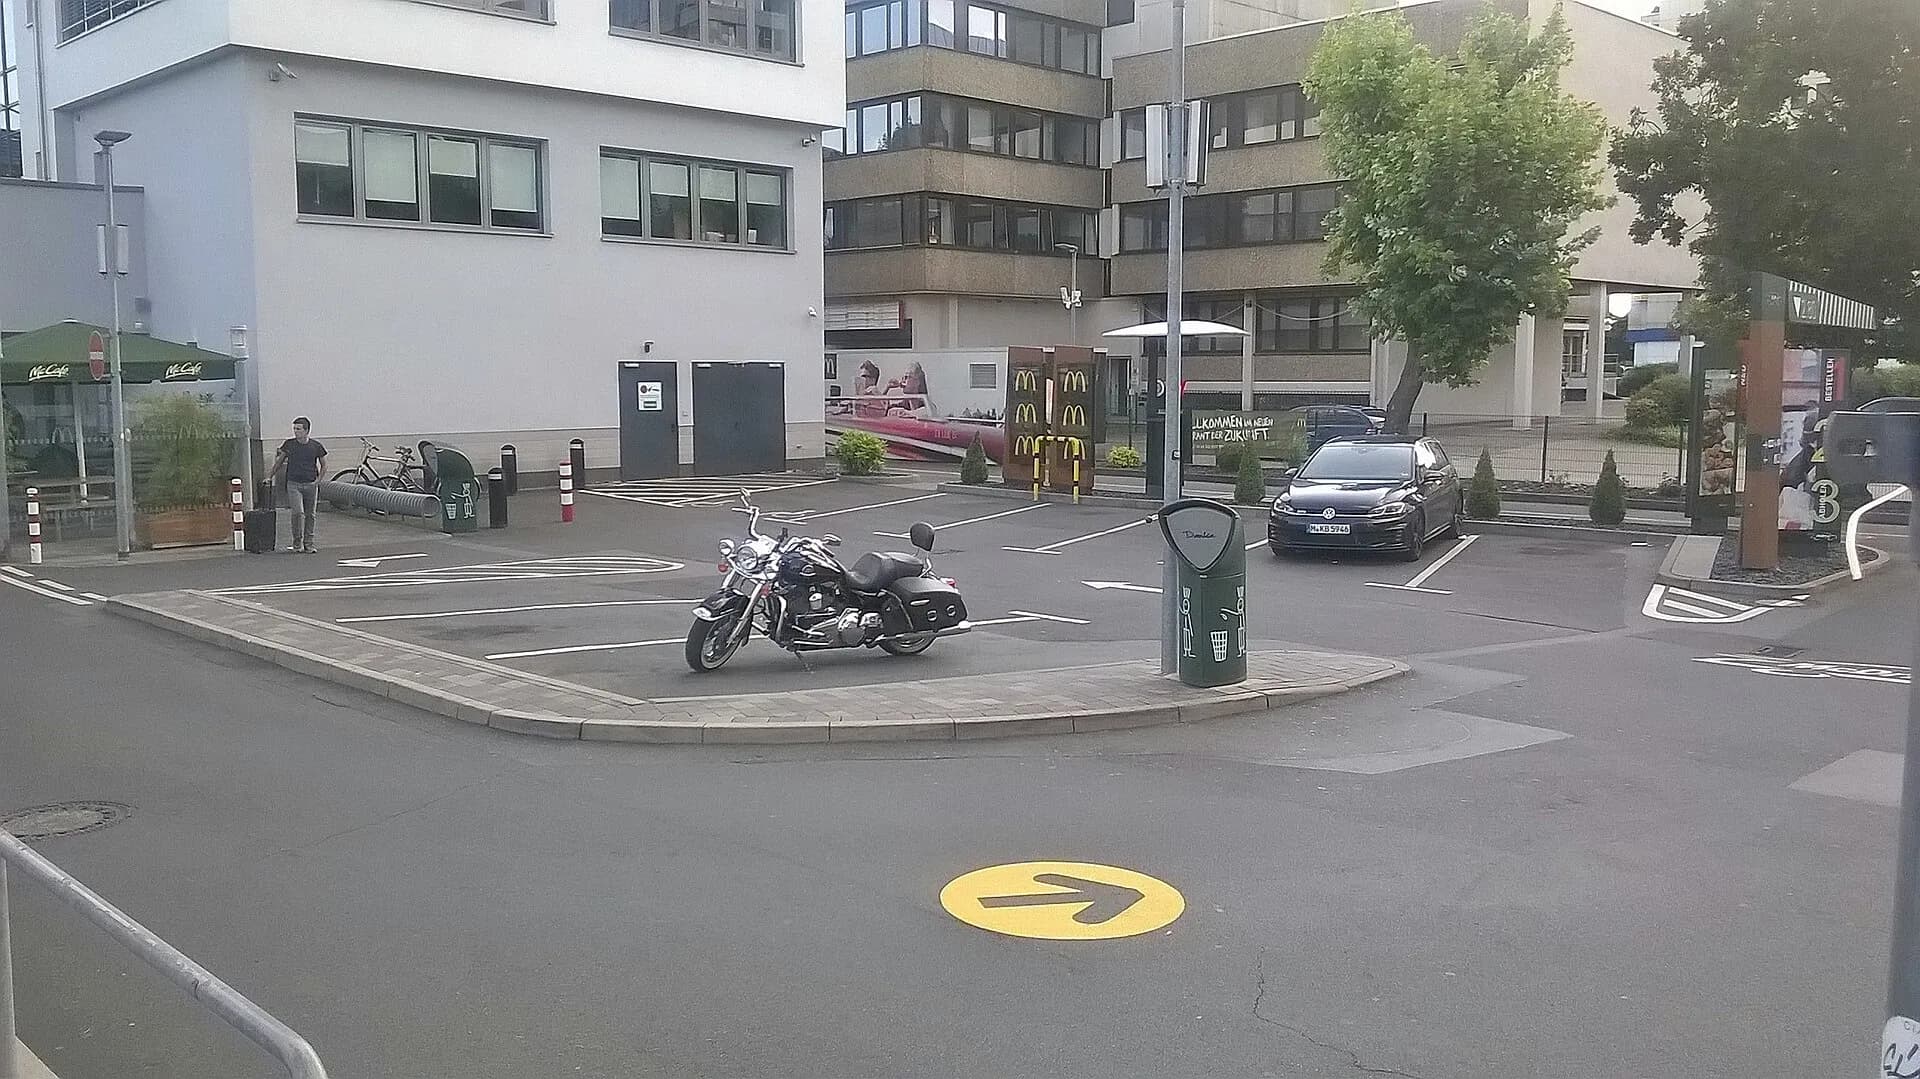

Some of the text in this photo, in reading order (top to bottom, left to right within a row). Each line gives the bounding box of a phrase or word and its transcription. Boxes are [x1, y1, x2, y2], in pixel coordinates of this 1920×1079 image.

[1824, 358, 1835, 402] BESTELLEN
[1192, 415, 1243, 430] LKOMMEN
[1811, 479, 1840, 523] 3
